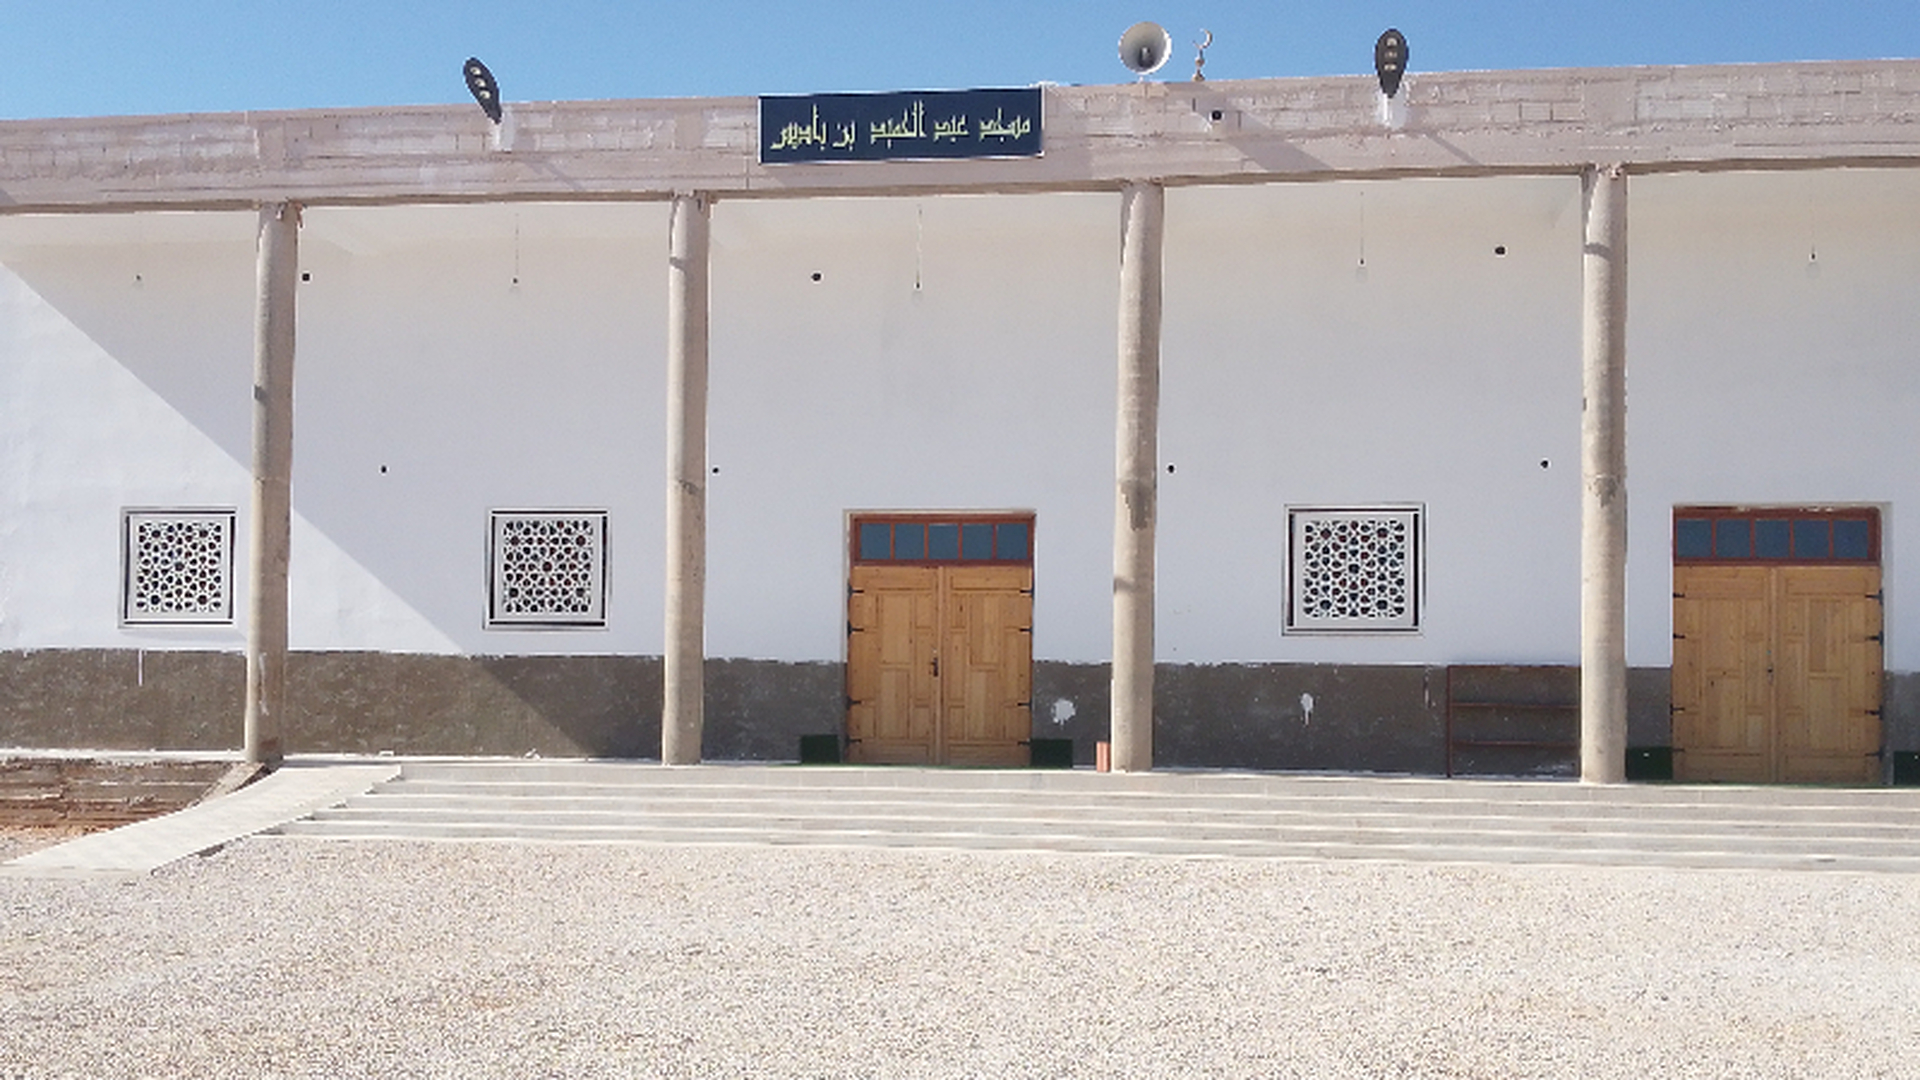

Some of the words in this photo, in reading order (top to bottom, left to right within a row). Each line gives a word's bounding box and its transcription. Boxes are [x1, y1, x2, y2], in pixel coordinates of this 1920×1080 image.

[770, 103, 827, 151] باديس
[832, 119, 856, 151] بن
[870, 100, 927, 149] الحميد
[933, 114, 969, 143] عبد
[979, 107, 1031, 142] مسجد
